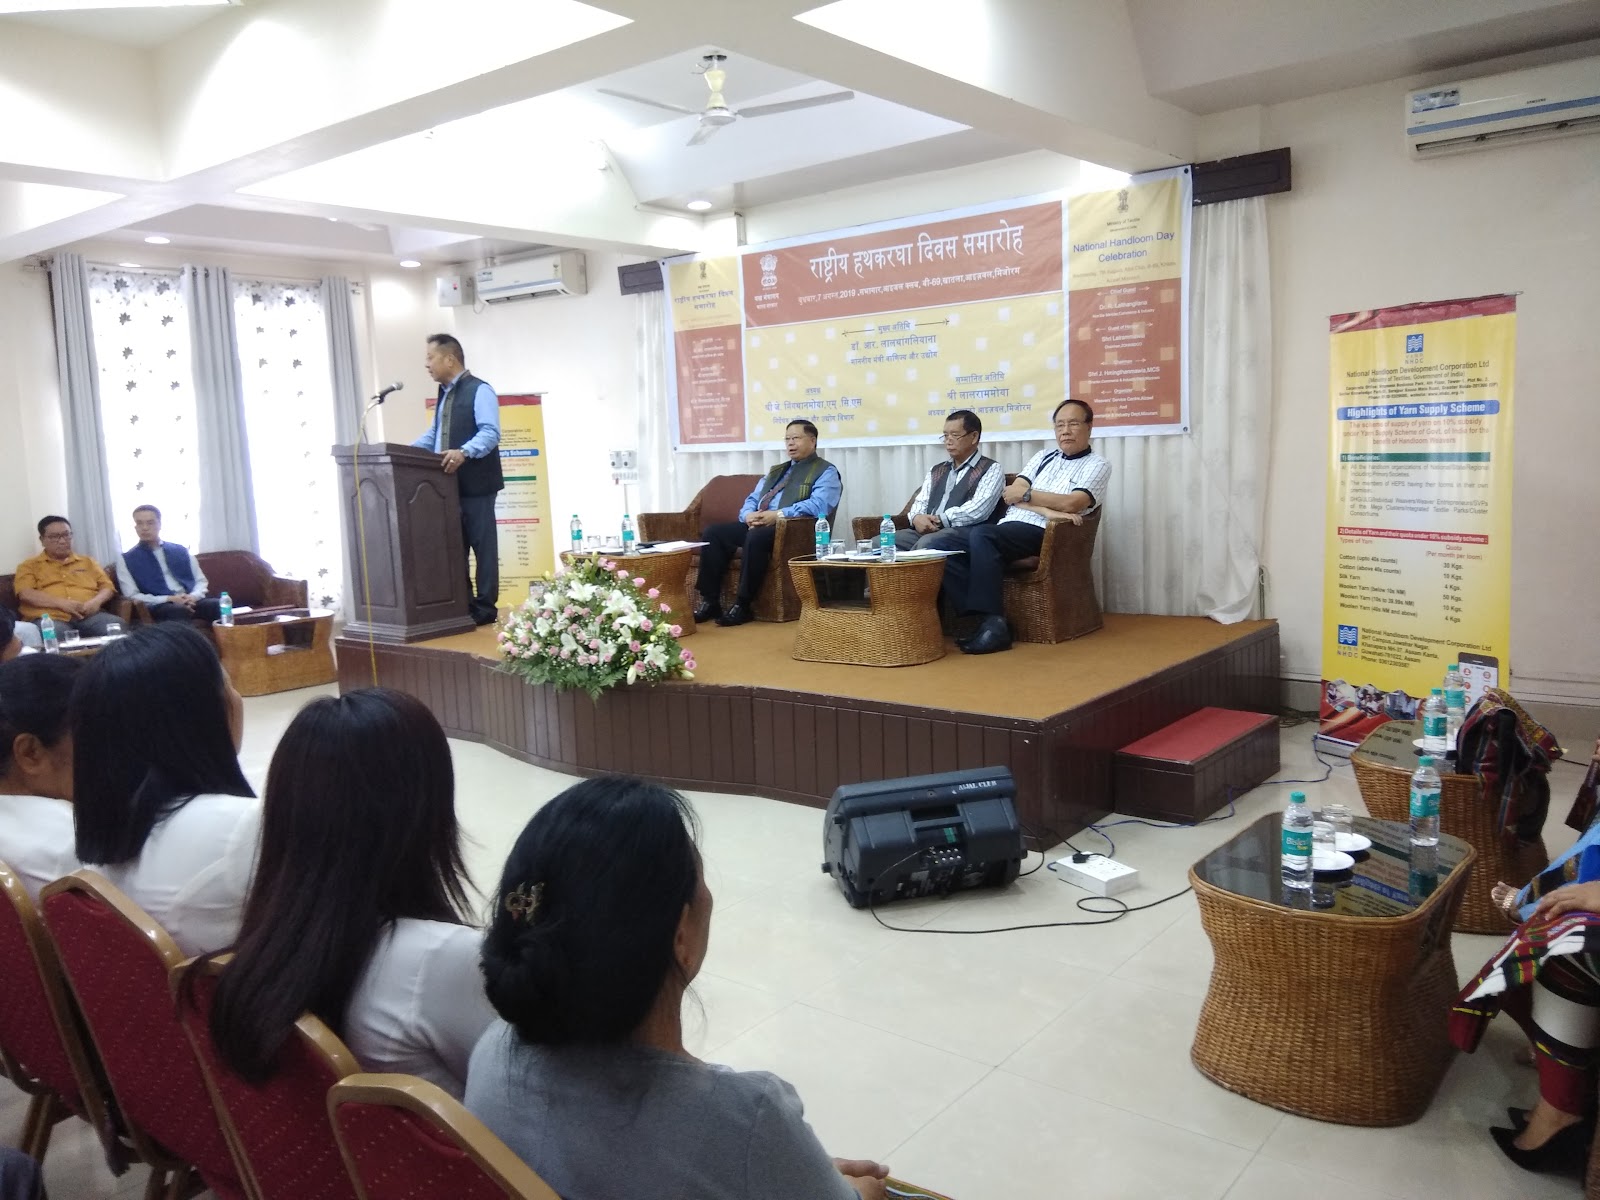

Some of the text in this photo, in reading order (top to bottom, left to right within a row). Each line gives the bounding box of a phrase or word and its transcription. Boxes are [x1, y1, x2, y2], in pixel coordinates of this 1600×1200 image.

[1073, 231, 1175, 253] National Handloom Day
[809, 219, 1024, 283] राष्ट्रीय हथकरघा दिवस समारोह
[1098, 250, 1148, 263] Celebration
[1346, 360, 1490, 378] National Handloom Development Corporation Ltd
[1347, 402, 1486, 418] Highlights of Yarn Supply Scheme
[1457, 417, 1482, 426] subsidy
[1339, 536, 1354, 544] Types
[1440, 534, 1463, 543] subsidy
[1463, 535, 1484, 543] scheme
[1451, 562, 1464, 570] Kgs.
[1383, 567, 1402, 575] counts)
[1451, 573, 1463, 581] Kgs.
[1449, 584, 1462, 592] Kgs.
[1340, 592, 1359, 600] Woolen
[1450, 594, 1463, 603] Kgs.
[1339, 602, 1358, 610] Woolen
[1361, 627, 1382, 635] National
[1382, 630, 1409, 639] Handloom
[1409, 634, 1445, 645] Development
[1446, 639, 1481, 650] Corporation
